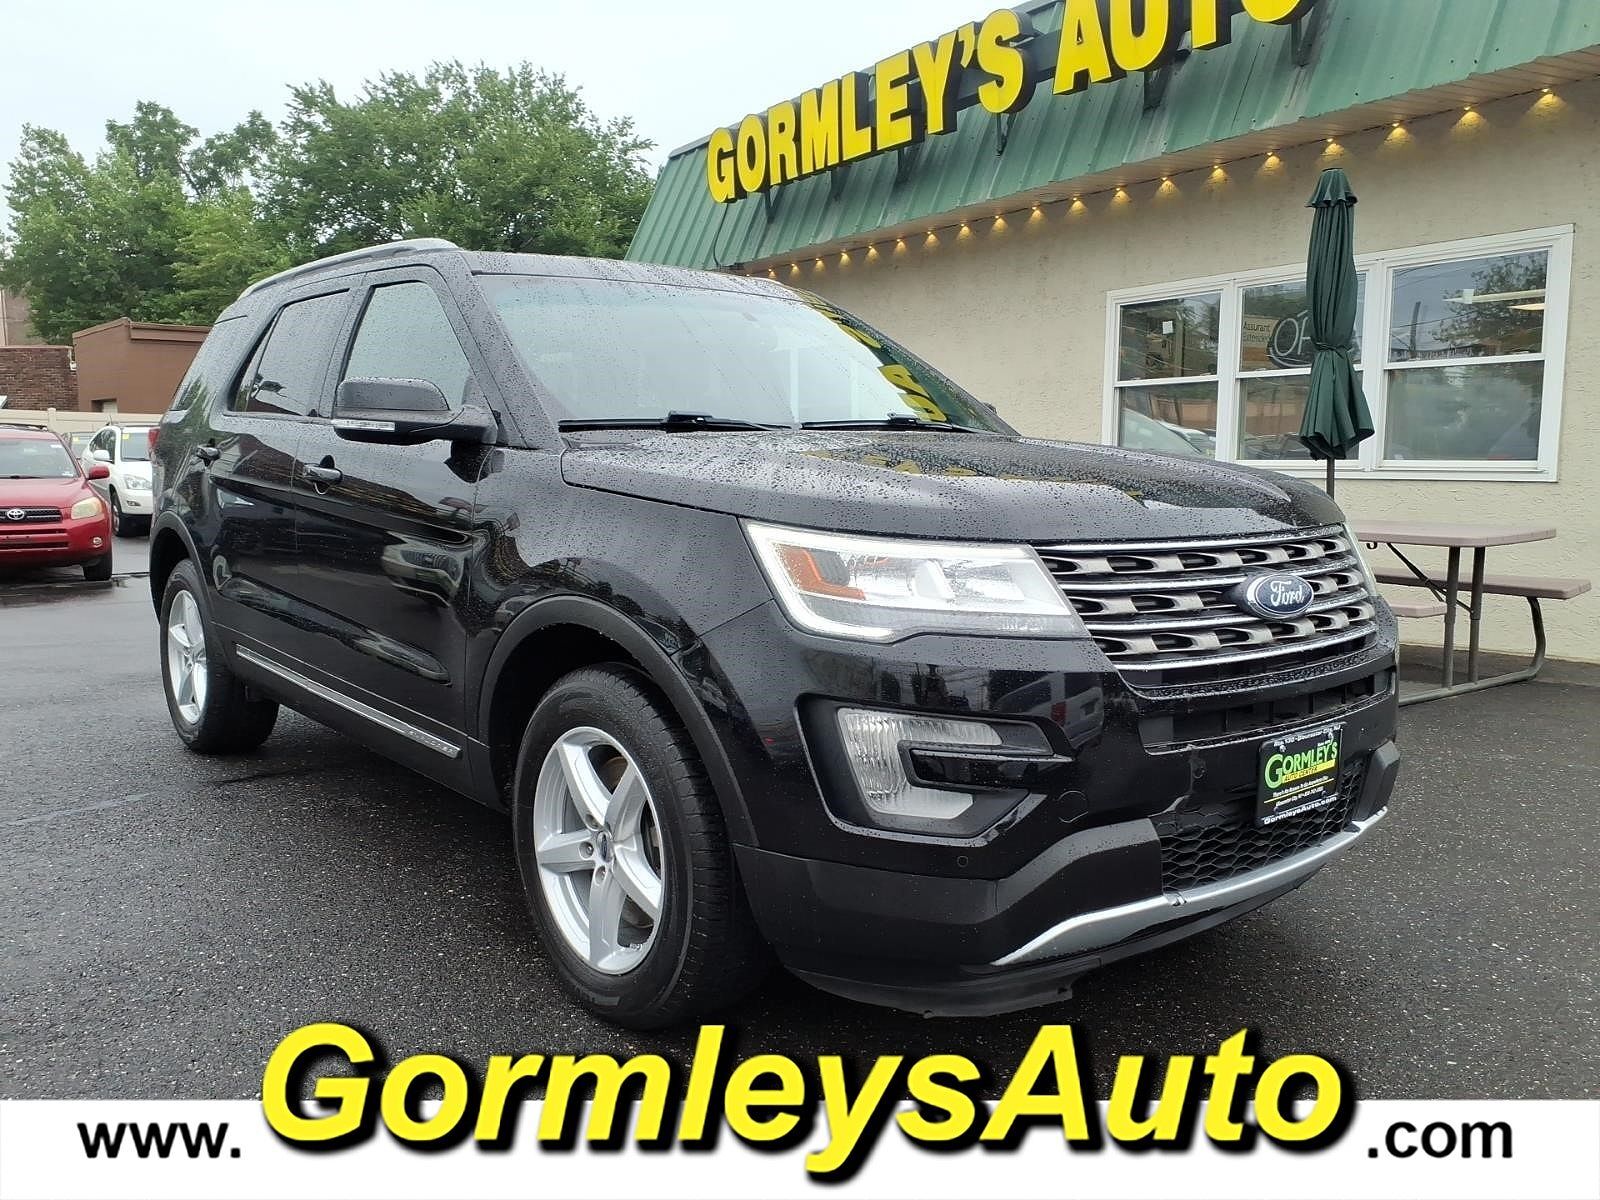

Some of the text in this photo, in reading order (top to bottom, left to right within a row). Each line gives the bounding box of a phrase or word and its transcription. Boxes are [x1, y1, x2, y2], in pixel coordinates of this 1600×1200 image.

[706, 0, 1300, 204] GORMLEY'S AU
[1270, 580, 1305, 607] Ford
[1264, 742, 1338, 788] GORMLEY'S
